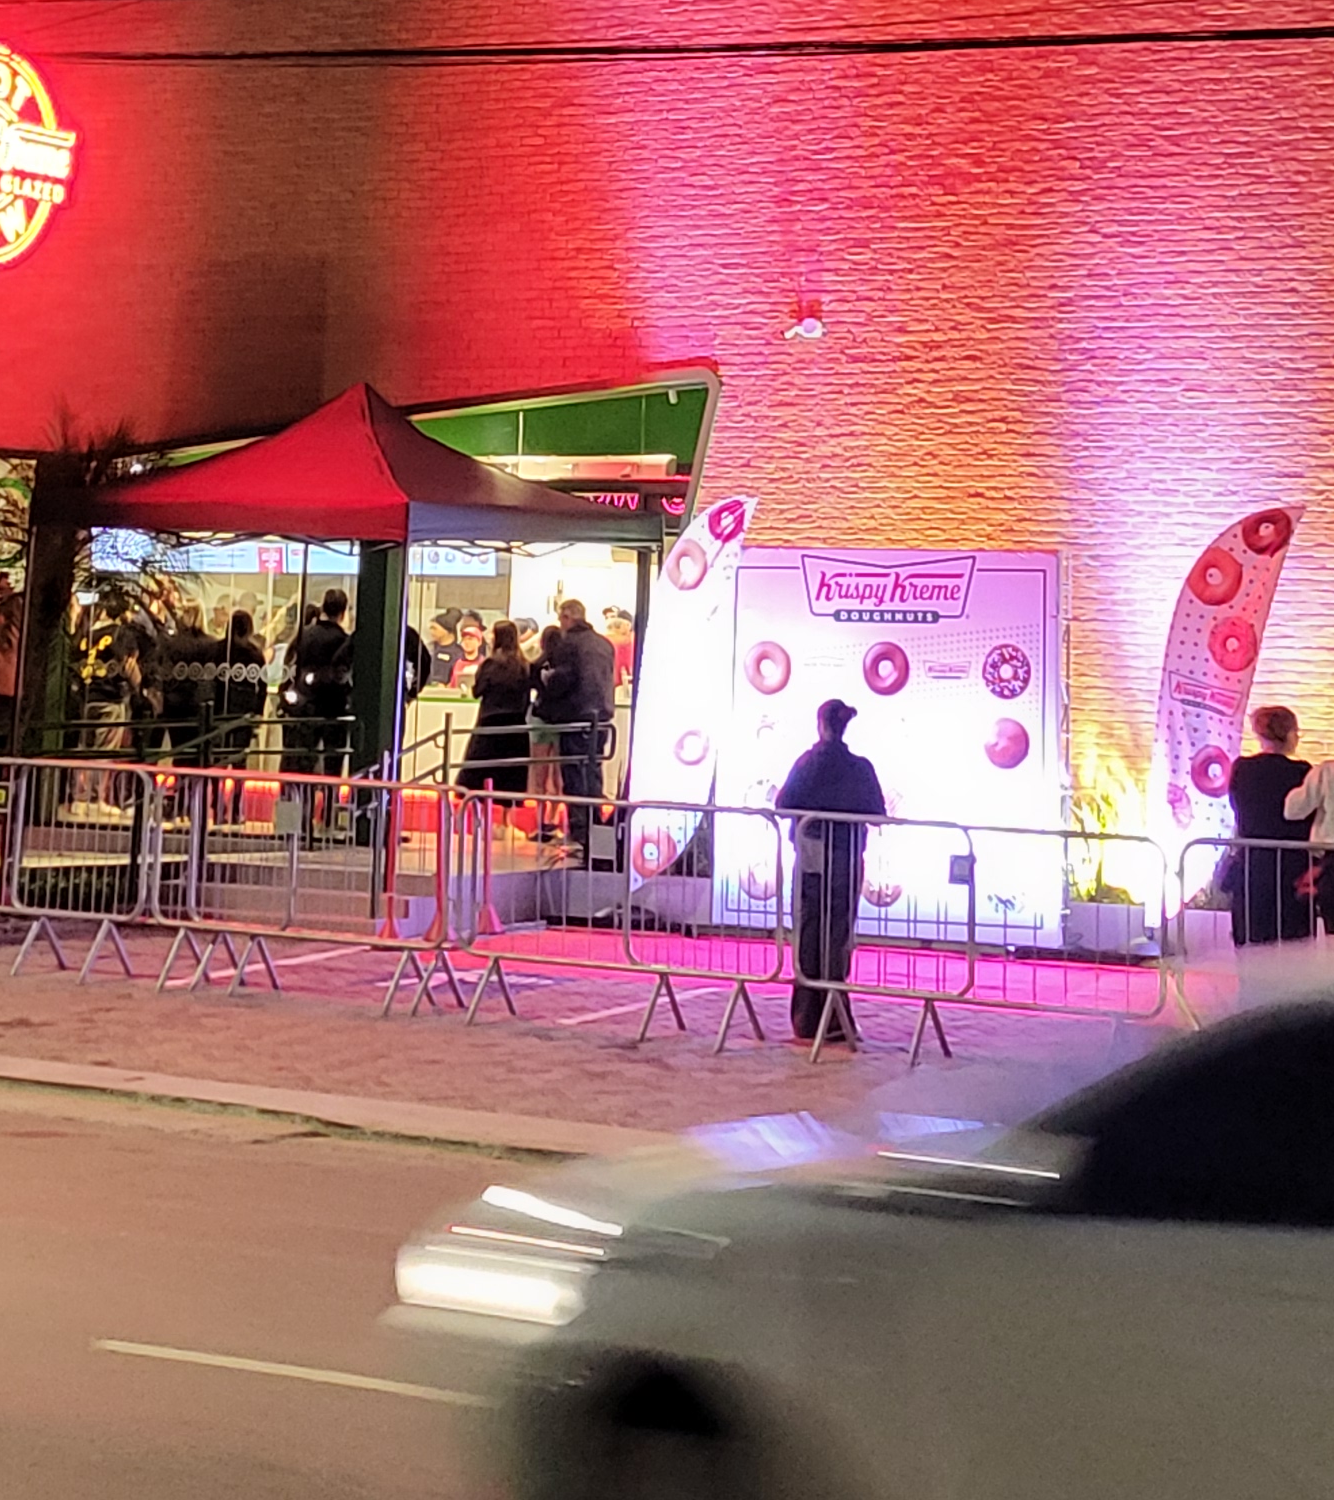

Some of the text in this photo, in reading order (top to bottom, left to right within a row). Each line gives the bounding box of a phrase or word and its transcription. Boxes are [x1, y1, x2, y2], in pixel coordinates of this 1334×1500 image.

[815, 570, 965, 607] Krispy Kreme
[839, 610, 934, 623] DOUGHNUTS
